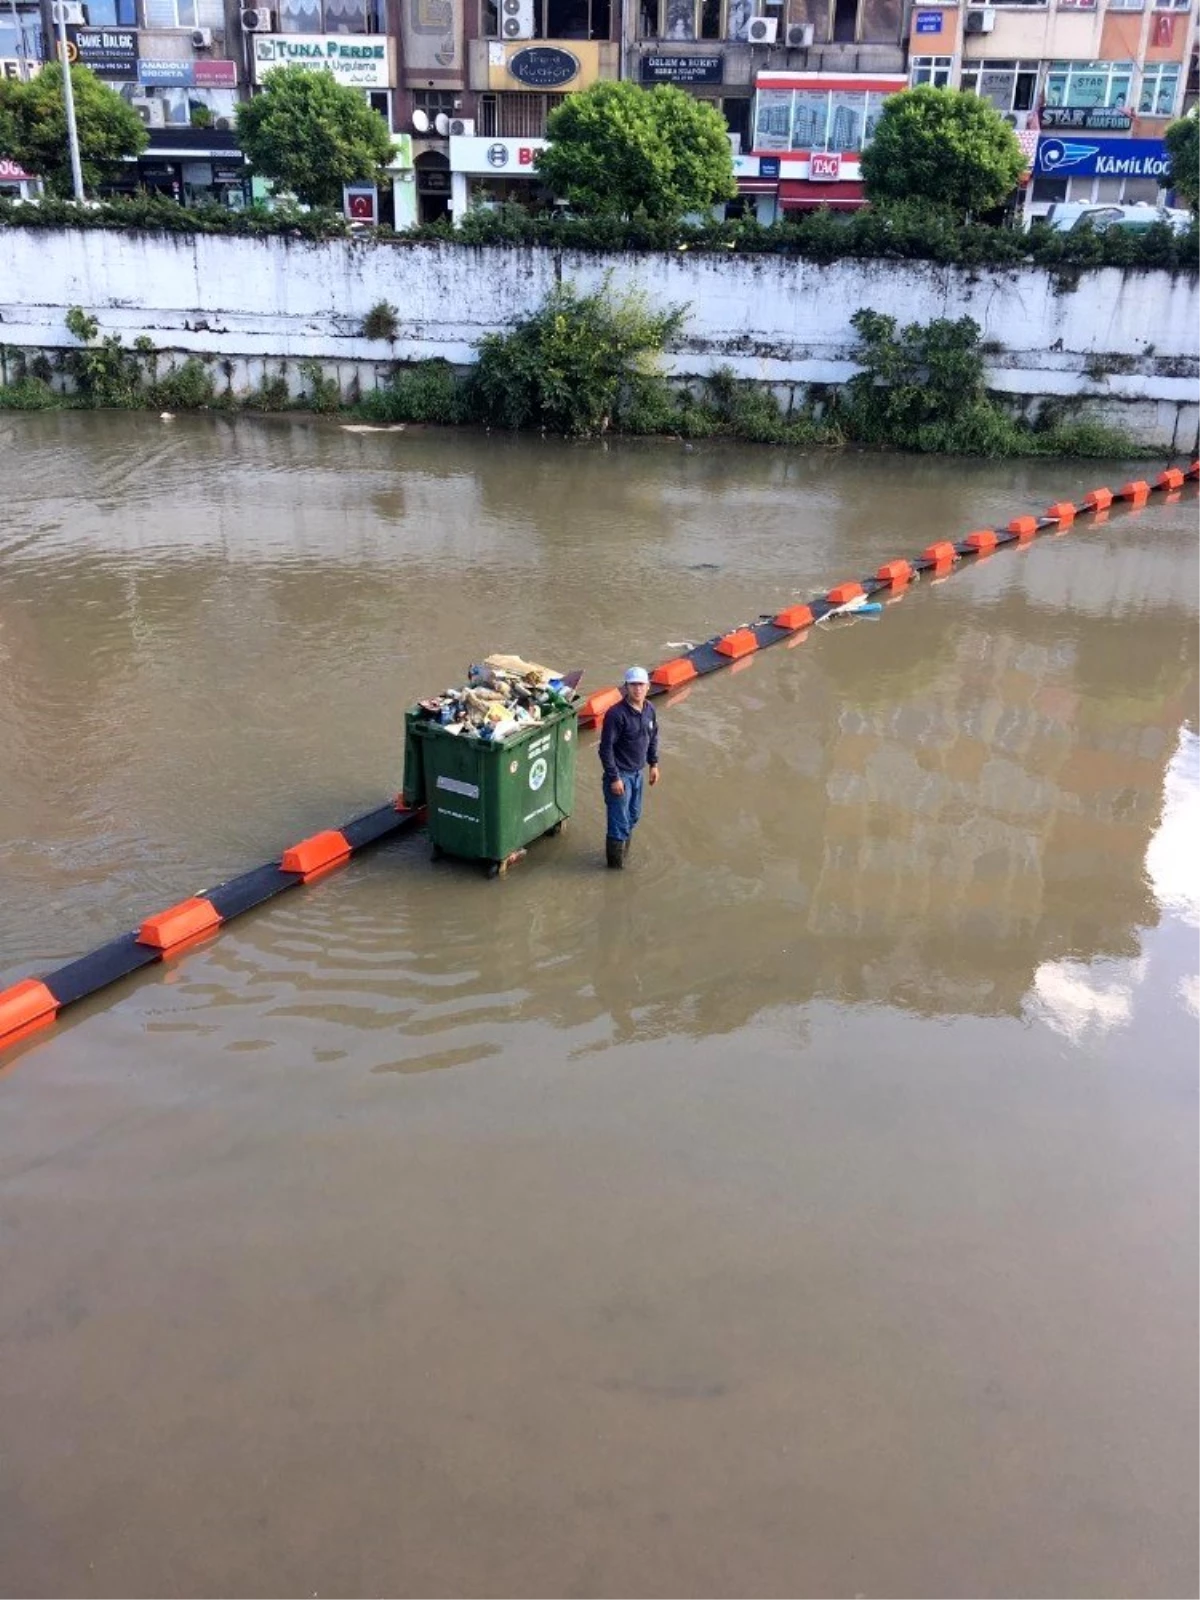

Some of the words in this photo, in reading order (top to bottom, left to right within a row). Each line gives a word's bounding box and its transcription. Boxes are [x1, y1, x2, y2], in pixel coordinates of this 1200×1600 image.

[276, 41, 324, 57] TUNA
[327, 41, 385, 59] PERDE
[332, 61, 377, 72] Uygulama
[1041, 110, 1085, 125] STAR
[813, 160, 837, 175] TAÇ
